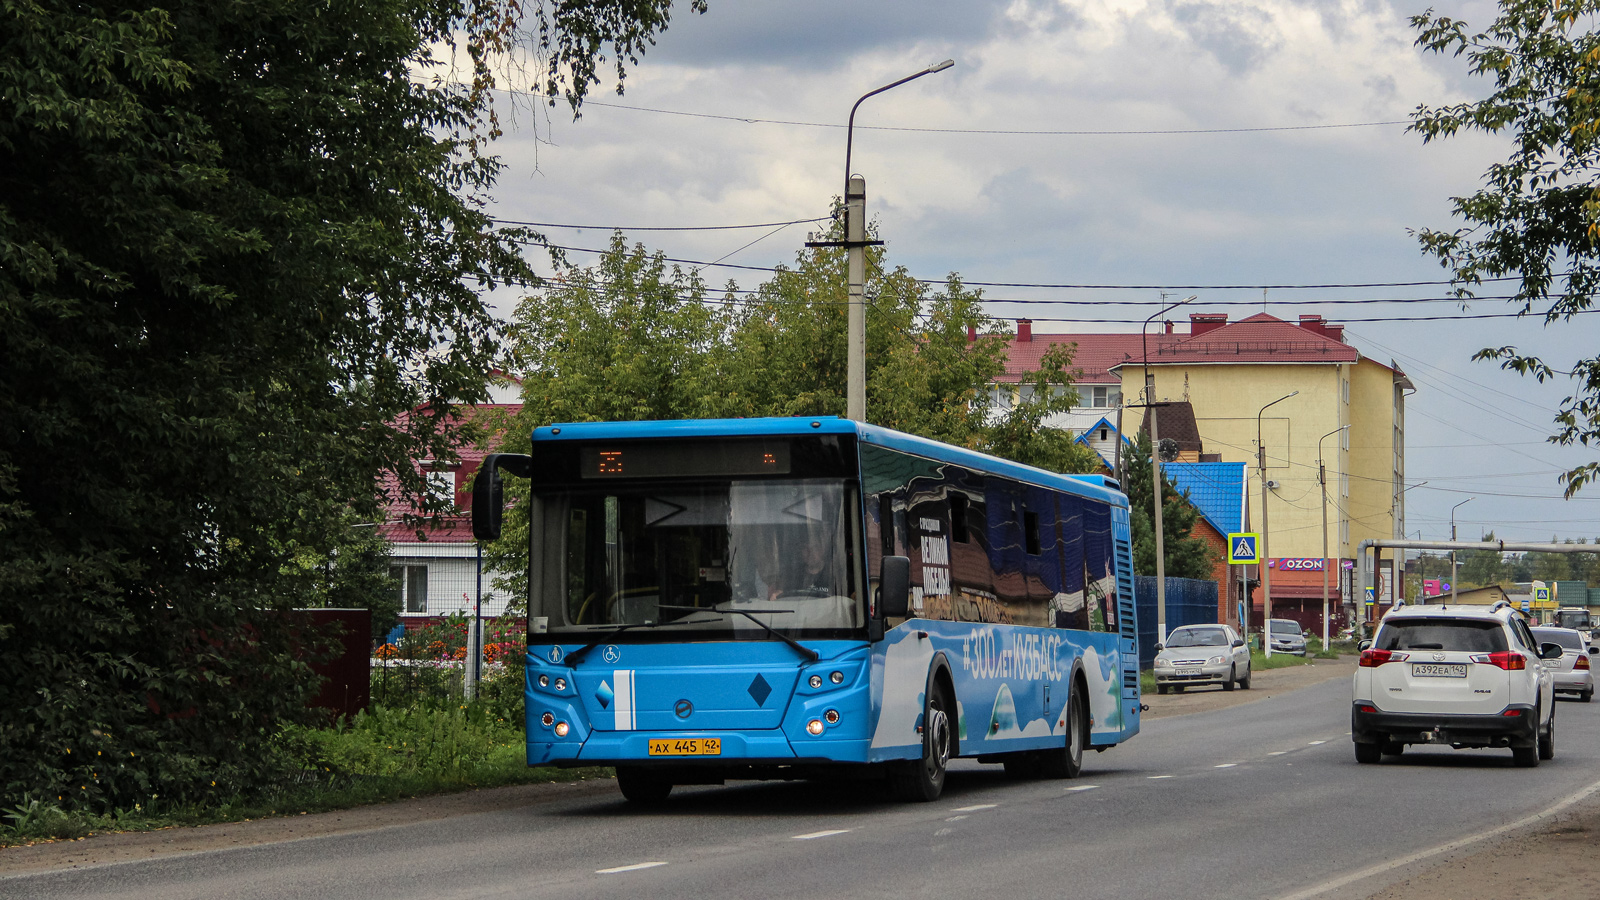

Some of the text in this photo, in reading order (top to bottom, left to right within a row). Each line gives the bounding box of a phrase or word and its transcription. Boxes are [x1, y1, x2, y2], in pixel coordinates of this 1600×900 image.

[920, 534, 949, 565] ВЕЛИКОЙ
[1286, 559, 1323, 569] OZON
[1415, 665, 1464, 674] А392ЕА 142
[655, 740, 716, 753] АХ 445 42
